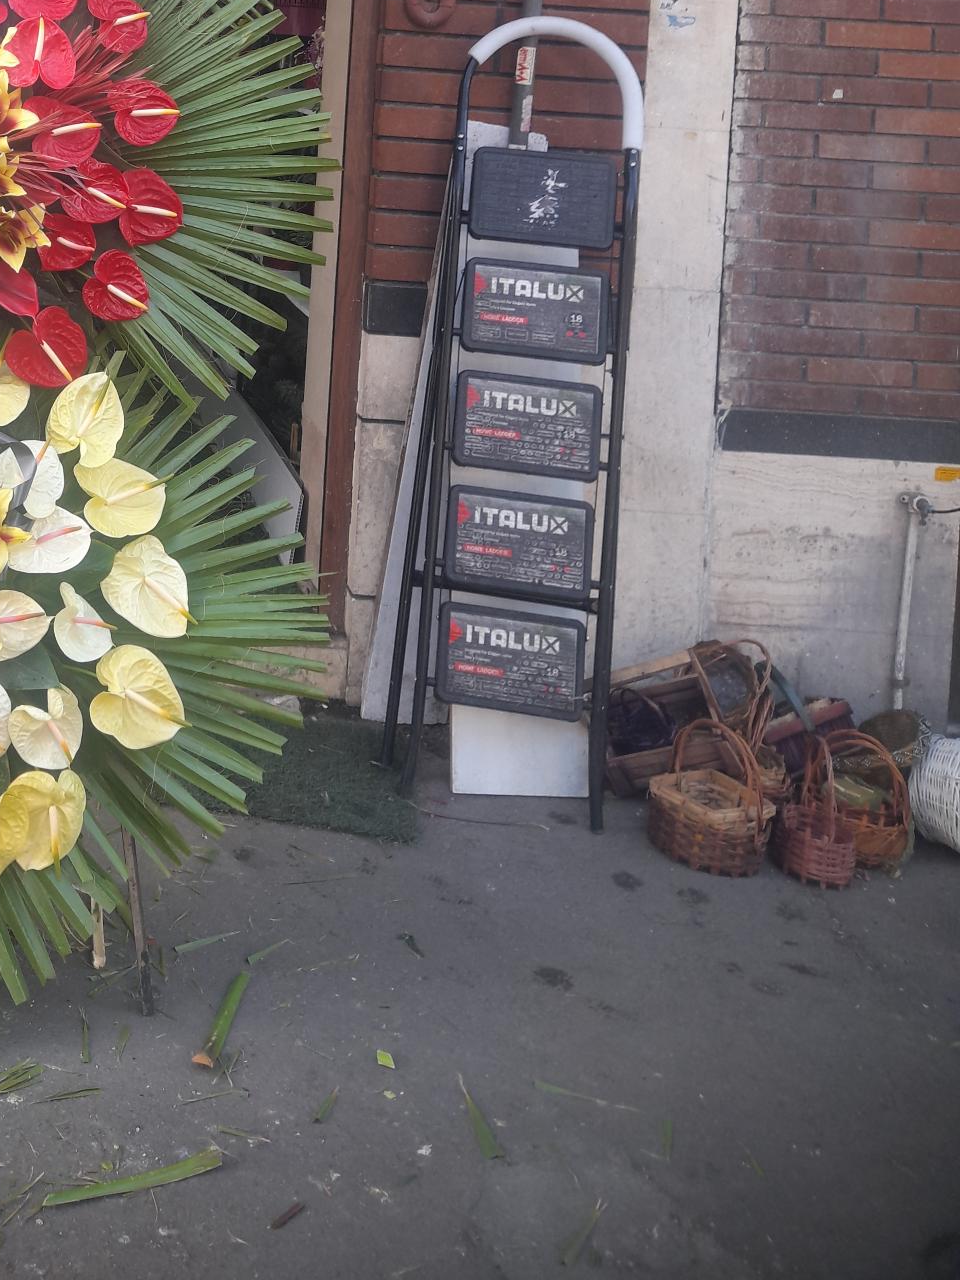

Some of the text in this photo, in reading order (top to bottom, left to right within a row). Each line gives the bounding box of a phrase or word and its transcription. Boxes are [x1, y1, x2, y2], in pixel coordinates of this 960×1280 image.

[489, 276, 585, 304] ITALUX
[482, 389, 578, 419] ITALUX
[473, 504, 569, 536] ITALUX
[464, 623, 561, 656] ITALUX
